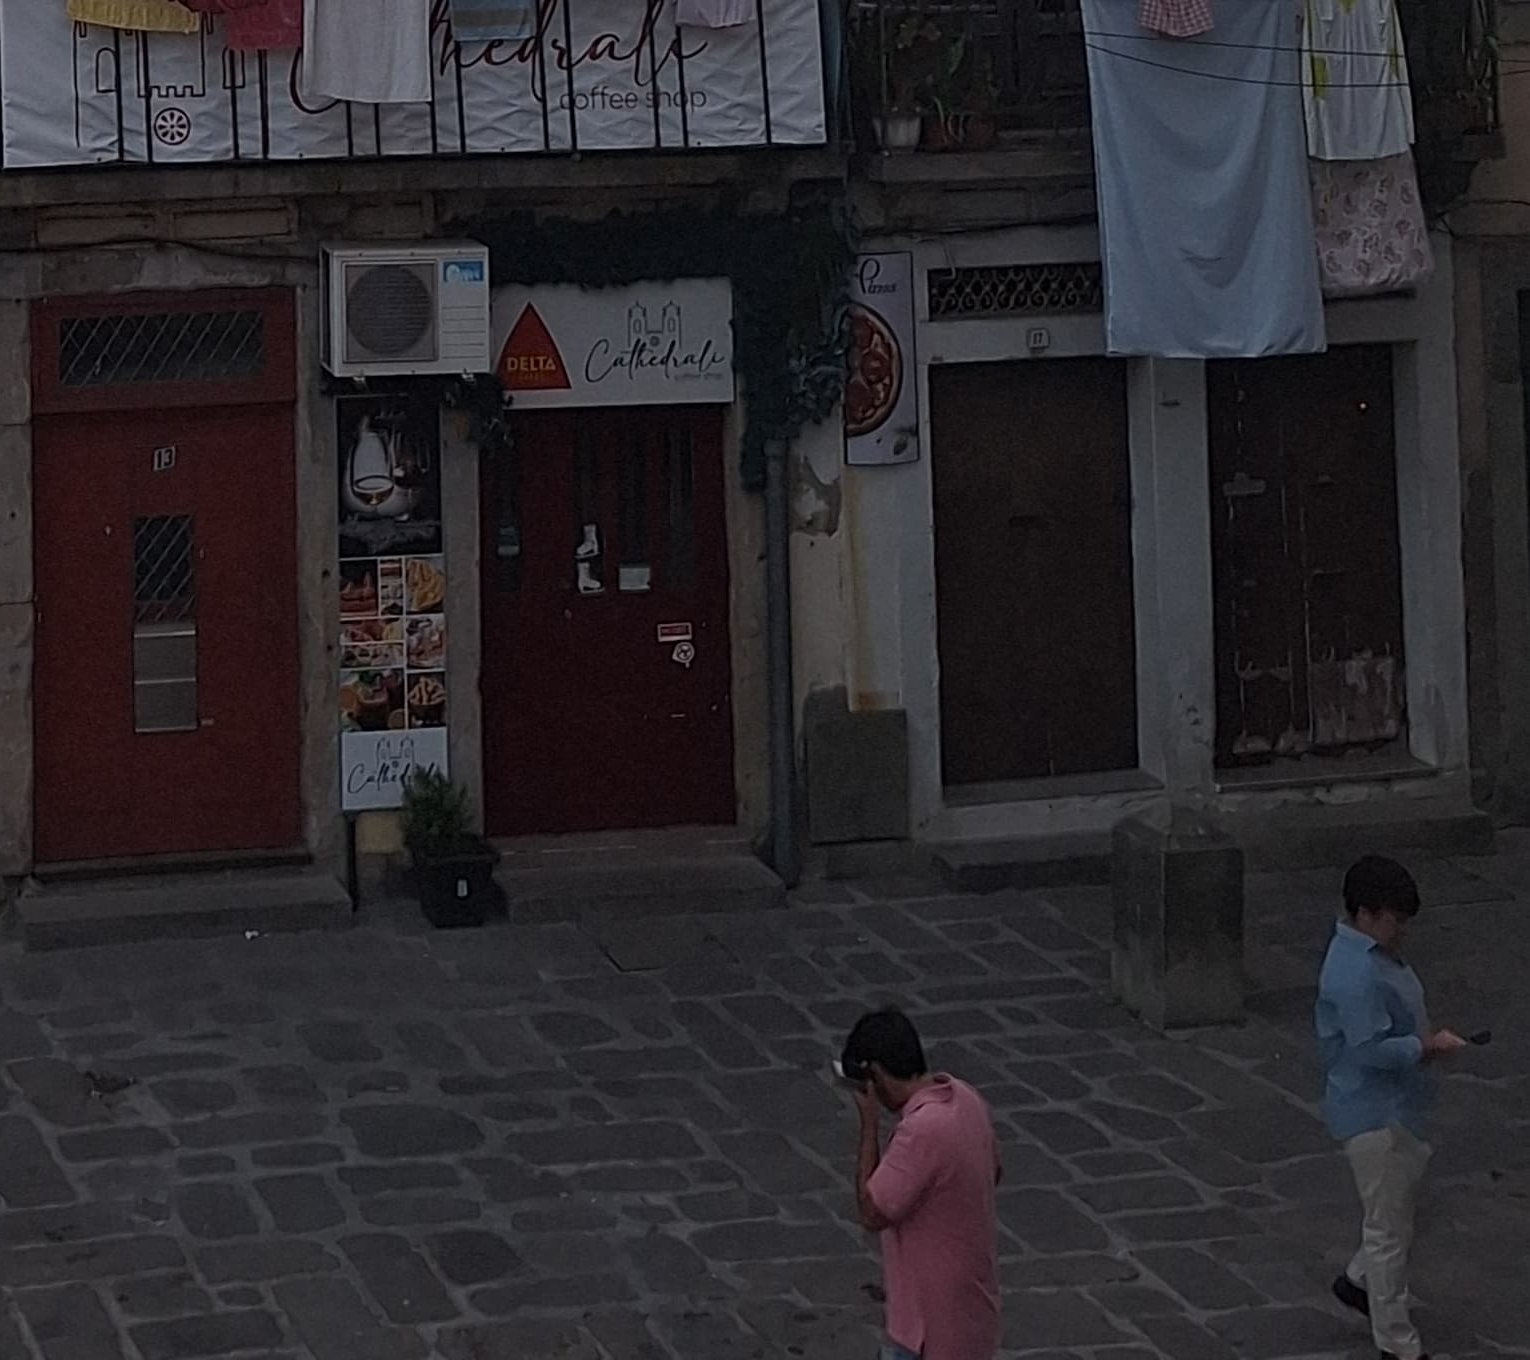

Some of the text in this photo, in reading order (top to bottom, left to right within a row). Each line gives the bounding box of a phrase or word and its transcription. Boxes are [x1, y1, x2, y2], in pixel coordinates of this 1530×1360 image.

[559, 84, 707, 113] coffee shop
[506, 355, 557, 372] DELTA
[157, 448, 173, 468] 13
